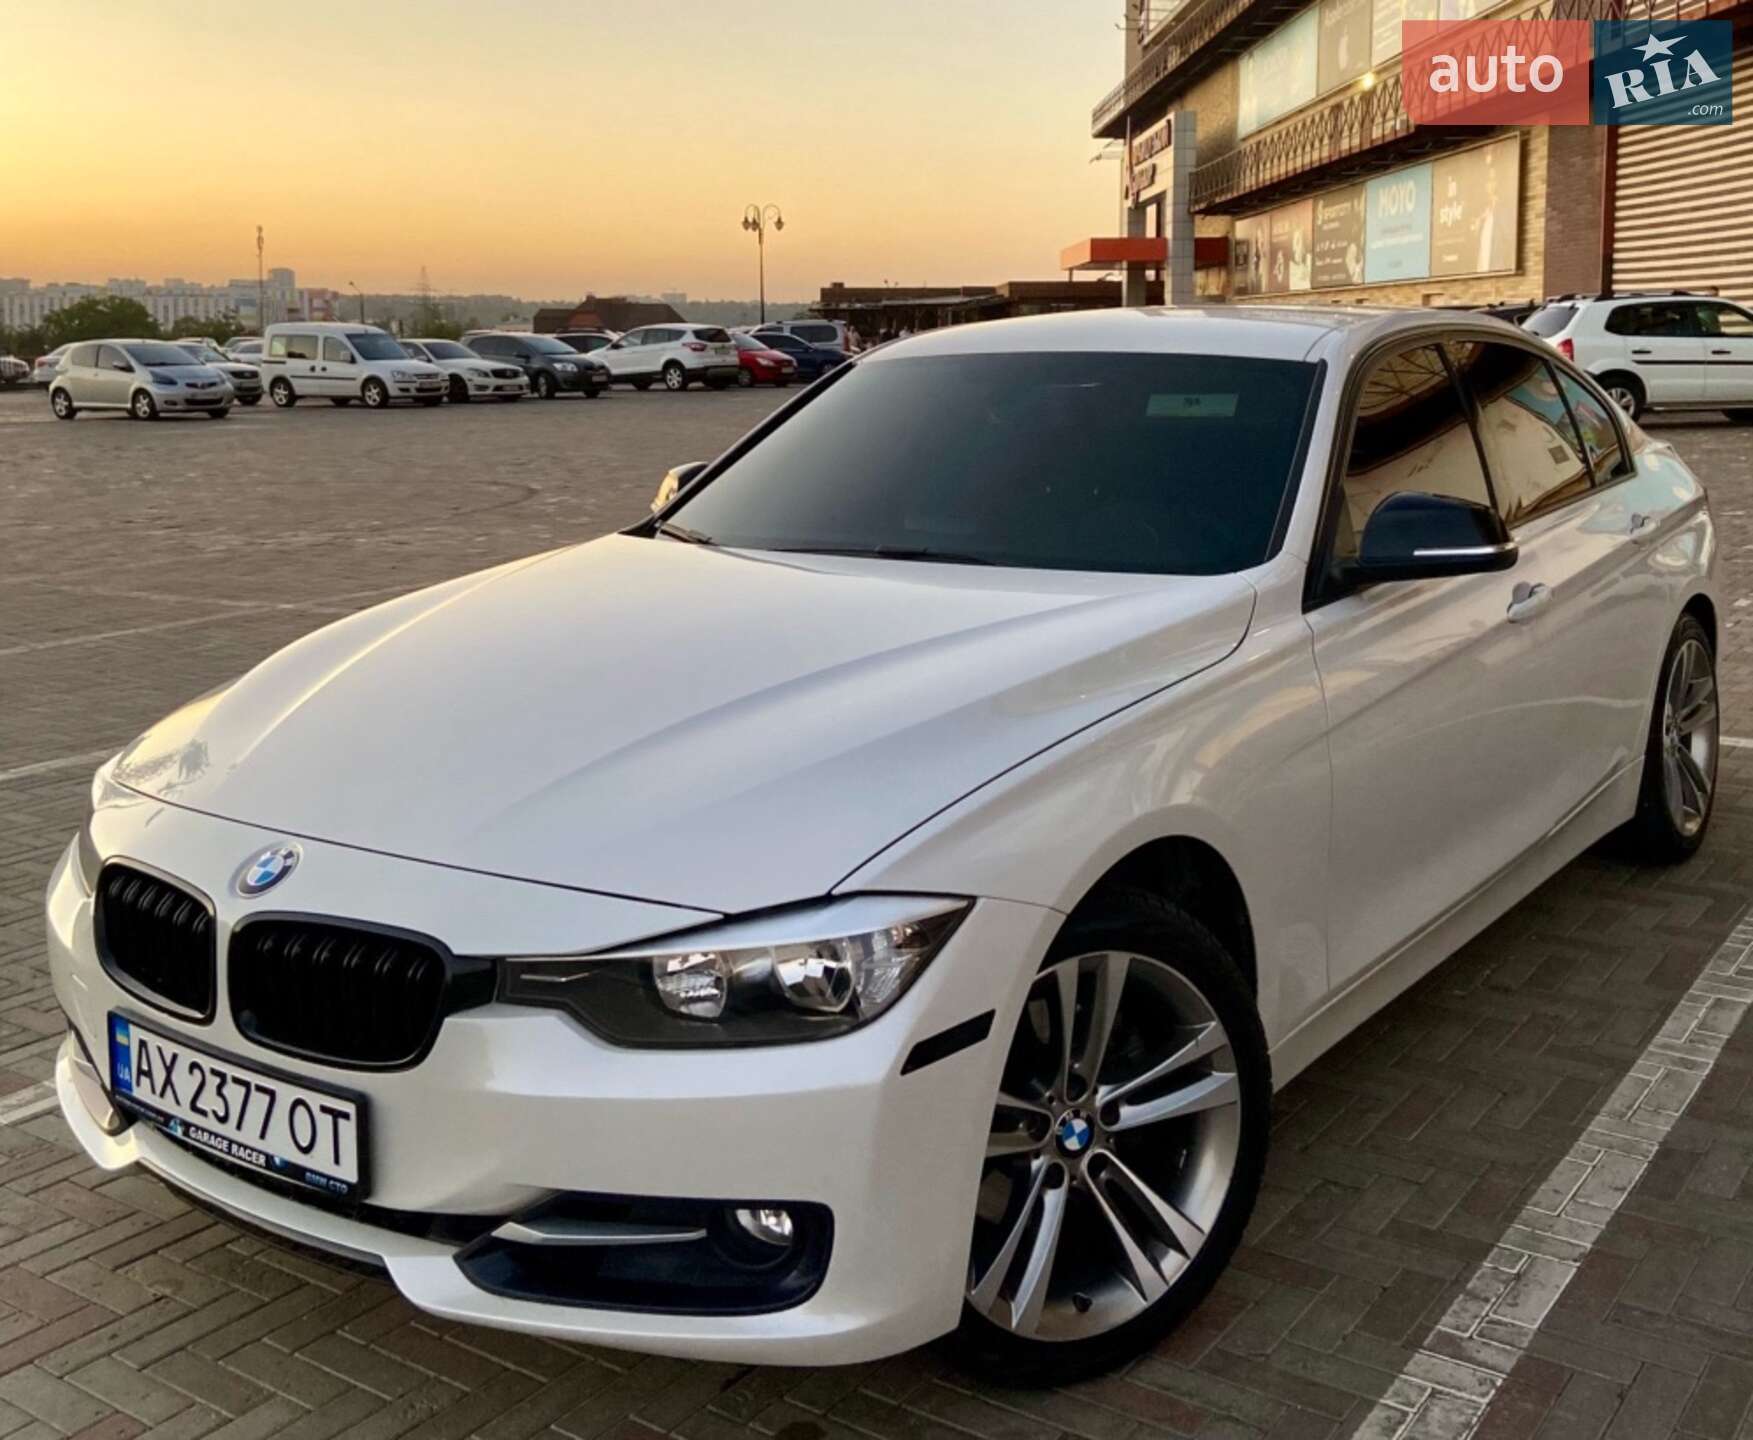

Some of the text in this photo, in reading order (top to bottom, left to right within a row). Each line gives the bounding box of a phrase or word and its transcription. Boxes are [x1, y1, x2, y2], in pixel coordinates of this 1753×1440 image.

[116, 1062, 132, 1083] UA
[136, 1038, 181, 1107] AX
[188, 1060, 277, 1141] 2377
[288, 1096, 351, 1167] OT
[188, 1126, 267, 1168] GARAGE RACER
